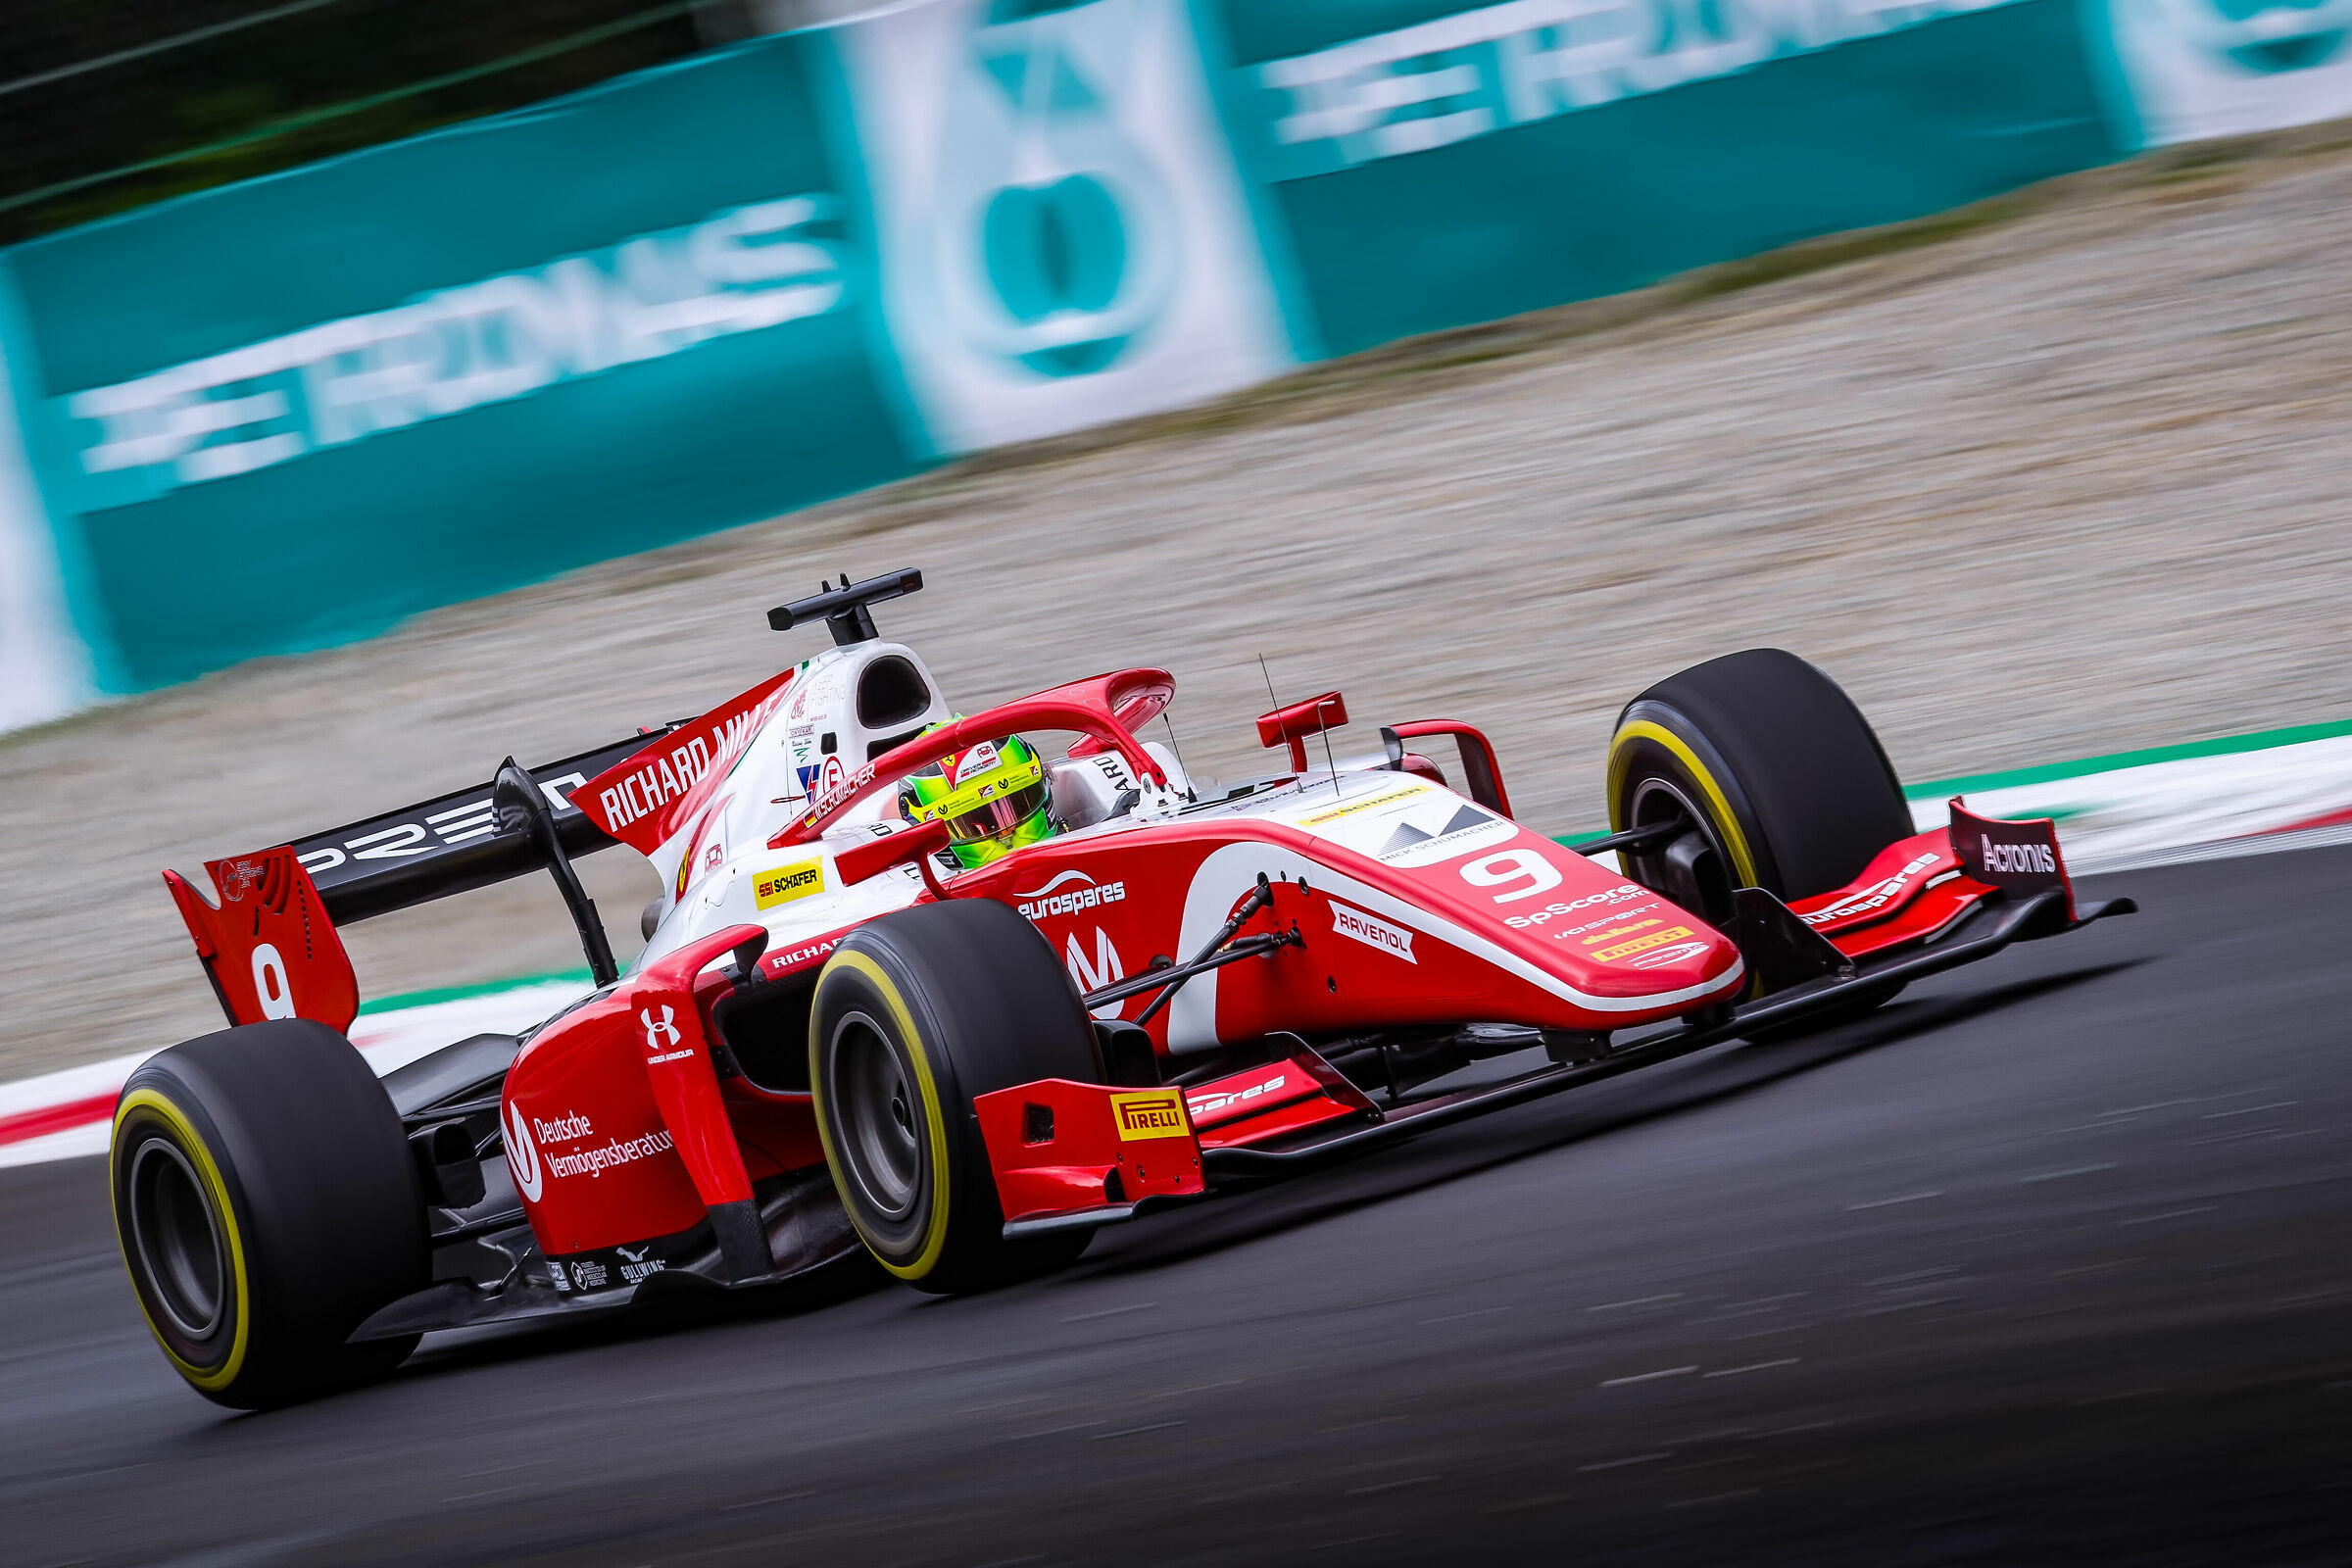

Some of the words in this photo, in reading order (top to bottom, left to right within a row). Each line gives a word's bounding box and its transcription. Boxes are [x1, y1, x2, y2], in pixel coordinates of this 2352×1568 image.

[600, 736, 710, 833] RICHARD
[712, 693, 780, 768] MILLE
[1380, 849, 1410, 862] MICK
[1415, 820, 1506, 851] SCHUMACHER
[1459, 849, 1563, 904] 9
[1018, 881, 1126, 921] eurospares
[1504, 884, 1640, 929] SpScore
[1607, 889, 1650, 906] .com
[533, 1109, 594, 1145] Deutsche
[1118, 1099, 1180, 1130] PIRELLI
